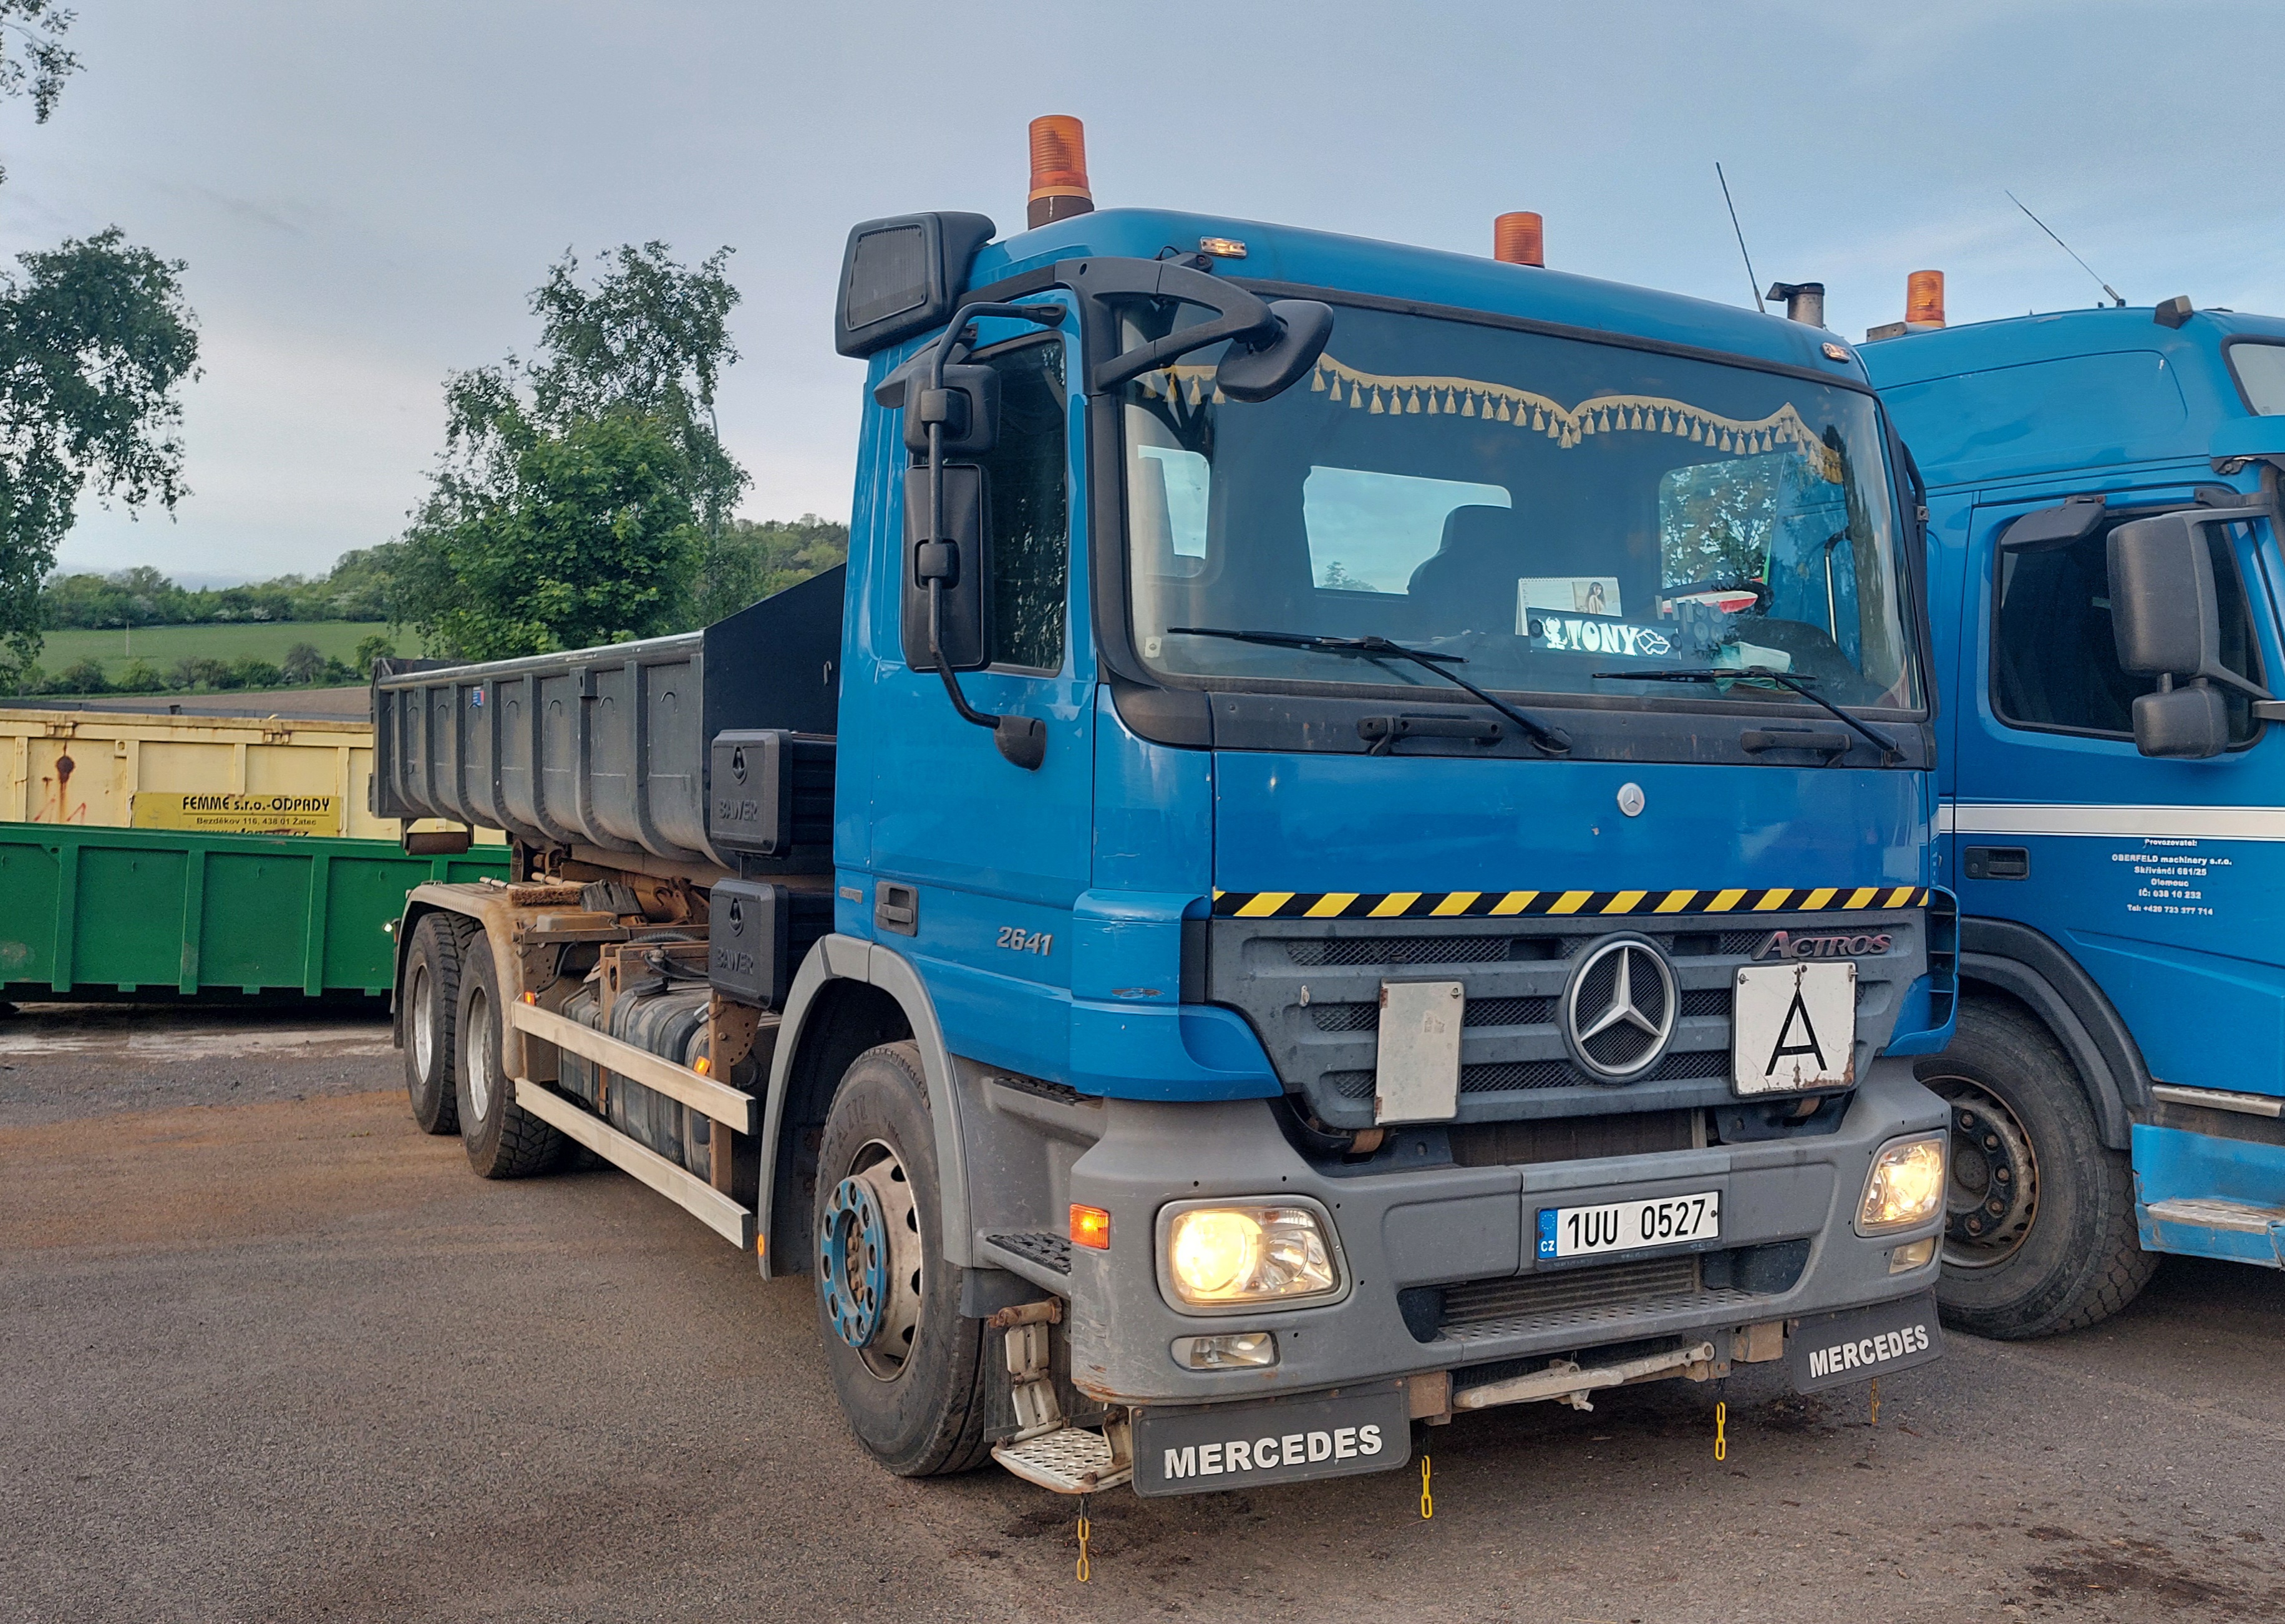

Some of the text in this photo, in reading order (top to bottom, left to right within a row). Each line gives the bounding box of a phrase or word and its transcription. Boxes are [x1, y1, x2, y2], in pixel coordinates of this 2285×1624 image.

[1565, 619, 1639, 656] TONY
[183, 796, 229, 810] FEMME
[293, 816, 316, 825] Žatec
[2112, 854, 2158, 863] OBERFELD
[2160, 856, 2207, 866] machinery
[2151, 878, 2189, 887] Olomouc
[2171, 890, 2182, 898] 10
[2184, 891, 2201, 899] 232
[2198, 907, 2213, 916] 714
[997, 926, 1052, 956] 2641
[1765, 987, 1828, 1076] A
[1541, 1199, 1705, 1252] CZ 1UU 0527
[1809, 1325, 1929, 1378] MERCEDES
[1164, 1424, 1382, 1479] MERCEDES
